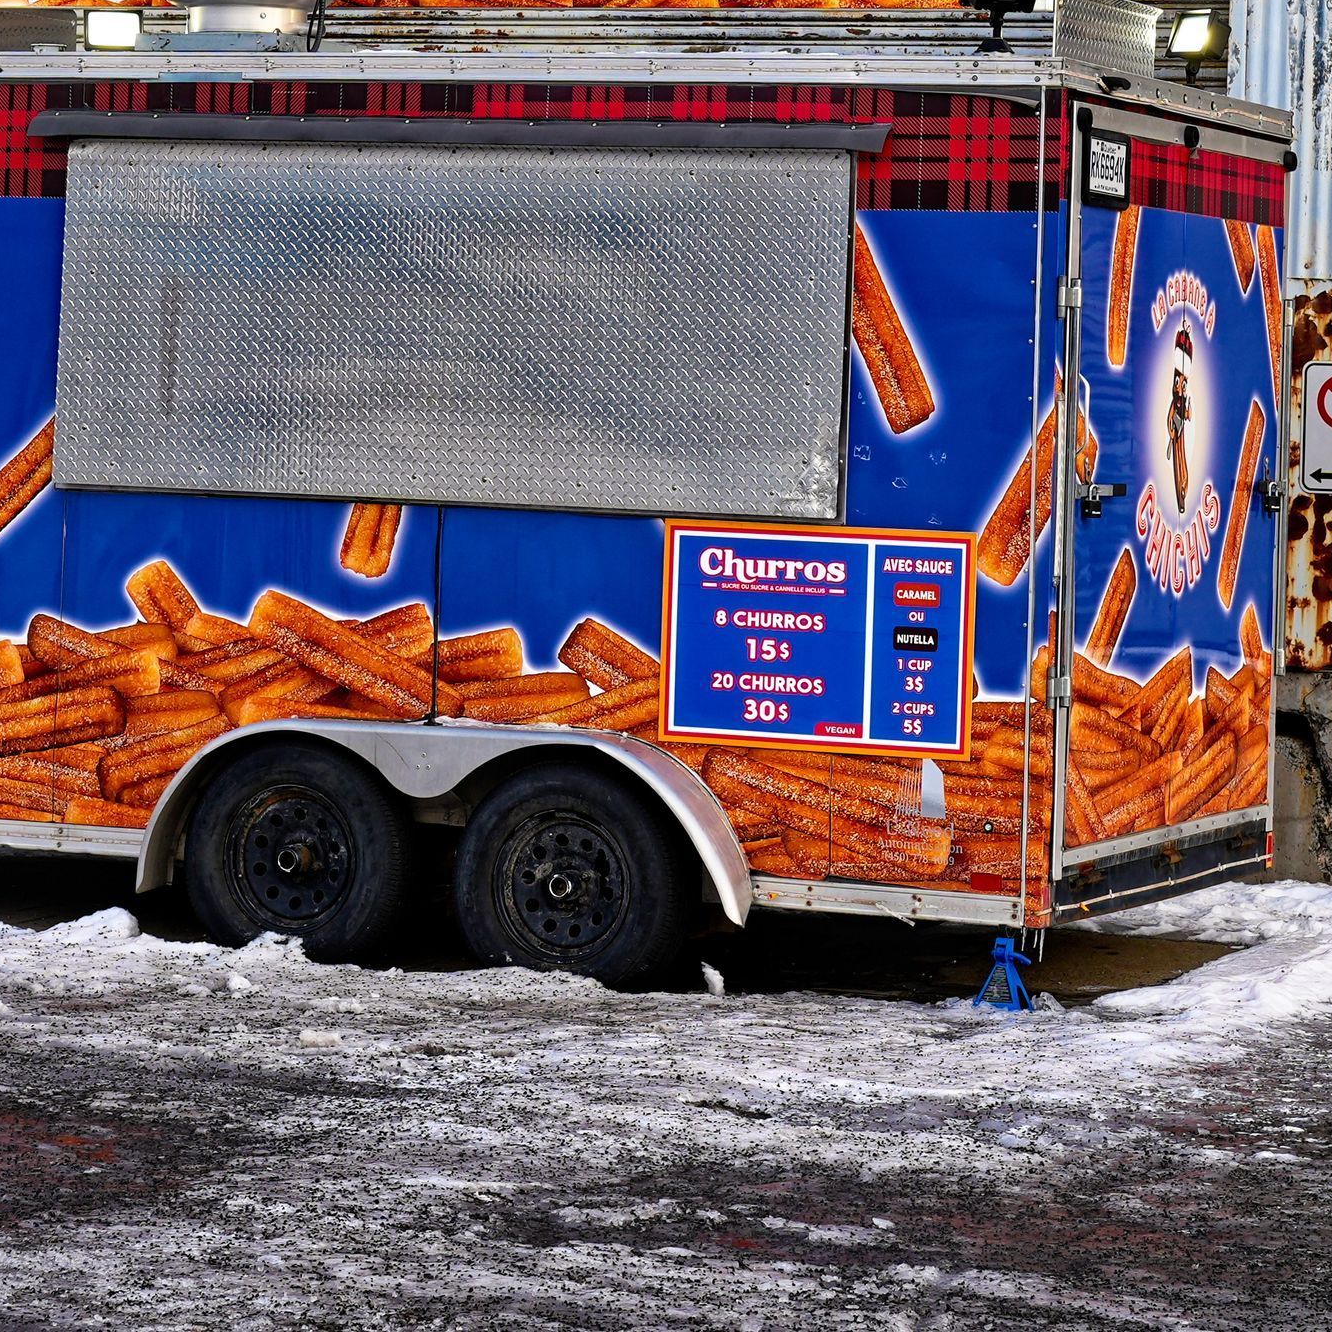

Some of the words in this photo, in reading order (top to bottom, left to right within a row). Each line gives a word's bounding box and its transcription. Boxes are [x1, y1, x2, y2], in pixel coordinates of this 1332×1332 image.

[1091, 151, 1125, 183] RK6694X
[1152, 294, 1166, 329] LA
[1168, 274, 1206, 317] CABANE
[1138, 484, 1220, 593] CHICHIS
[699, 548, 846, 583] Churros
[884, 558, 913, 572] AVEC
[915, 560, 953, 574] SAUCE
[775, 585, 804, 593] CANNELLE
[896, 589, 936, 600] CARAMEL
[716, 610, 727, 625] 8
[733, 611, 824, 631] CHURROS
[908, 611, 924, 621] OU
[896, 634, 935, 645] NUTELLA
[746, 638, 790, 660] 15$
[897, 658, 903, 670] 1
[908, 659, 932, 671] CUP
[712, 673, 734, 689] 20
[738, 674, 823, 694] CHURROS
[905, 676, 923, 692] 3$
[743, 699, 789, 721] 30$
[892, 702, 900, 713] 2
[903, 703, 934, 715] CUPS
[824, 725, 855, 734] VEGAN
[903, 719, 922, 735] 5$
